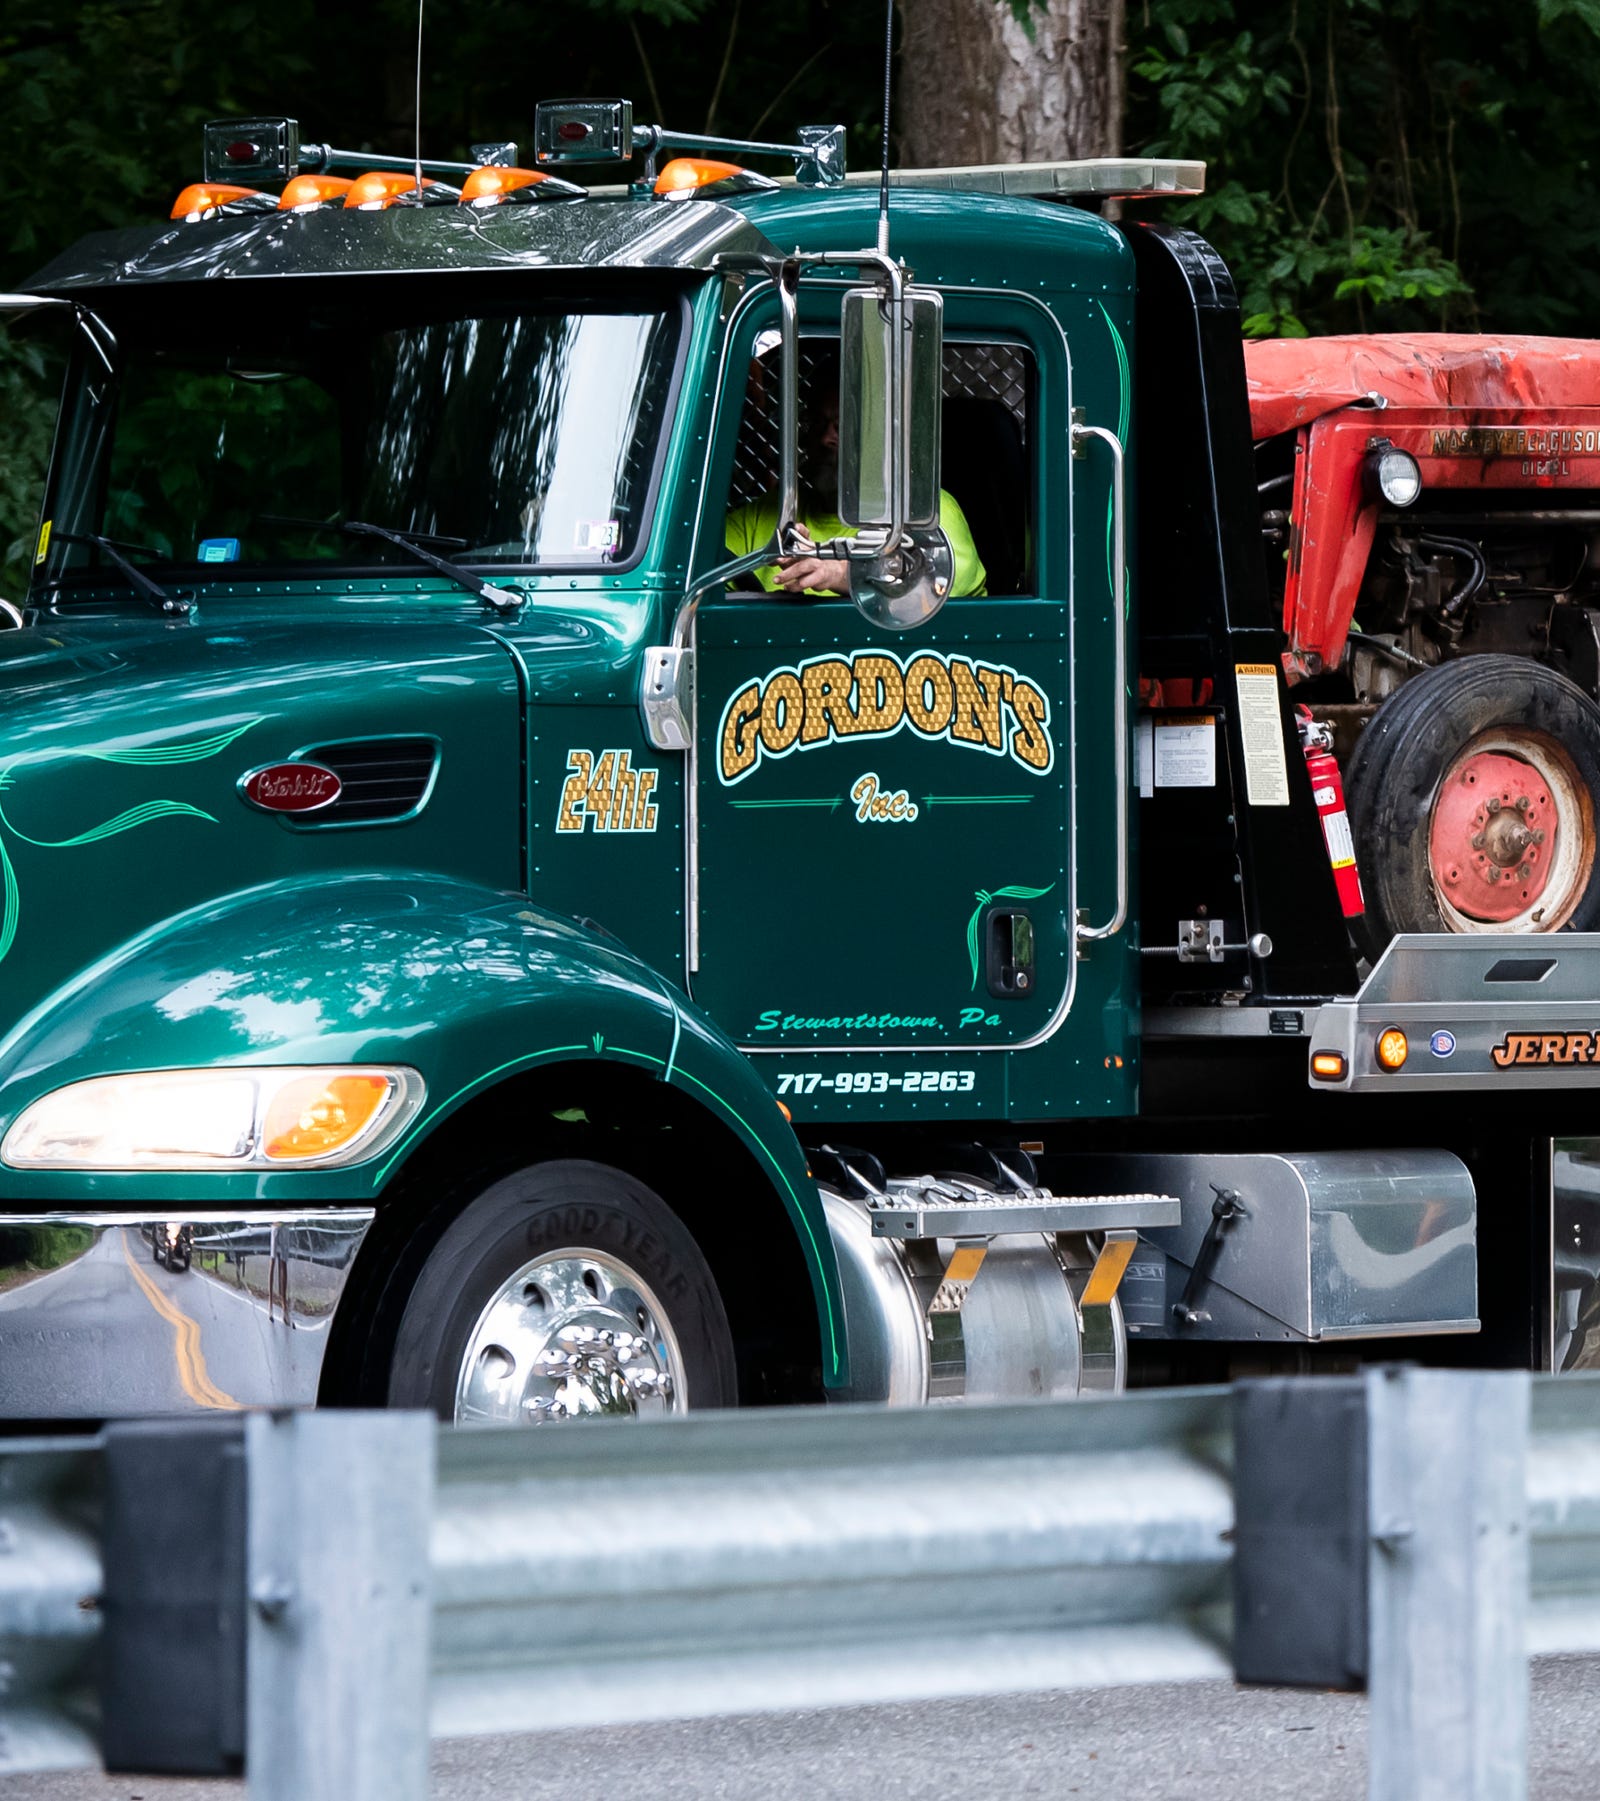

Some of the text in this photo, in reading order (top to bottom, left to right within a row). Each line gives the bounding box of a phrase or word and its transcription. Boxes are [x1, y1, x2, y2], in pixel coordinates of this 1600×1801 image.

[1244, 666, 1276, 675] WARNING
[717, 649, 1055, 785] GORDON'S
[257, 772, 331, 800] Peterbilt
[850, 772, 919, 823] Inc.
[959, 1007, 1002, 1029] Pa
[777, 1070, 976, 1094] 717-993-2263
[526, 1207, 689, 1299] GOODYEAR
